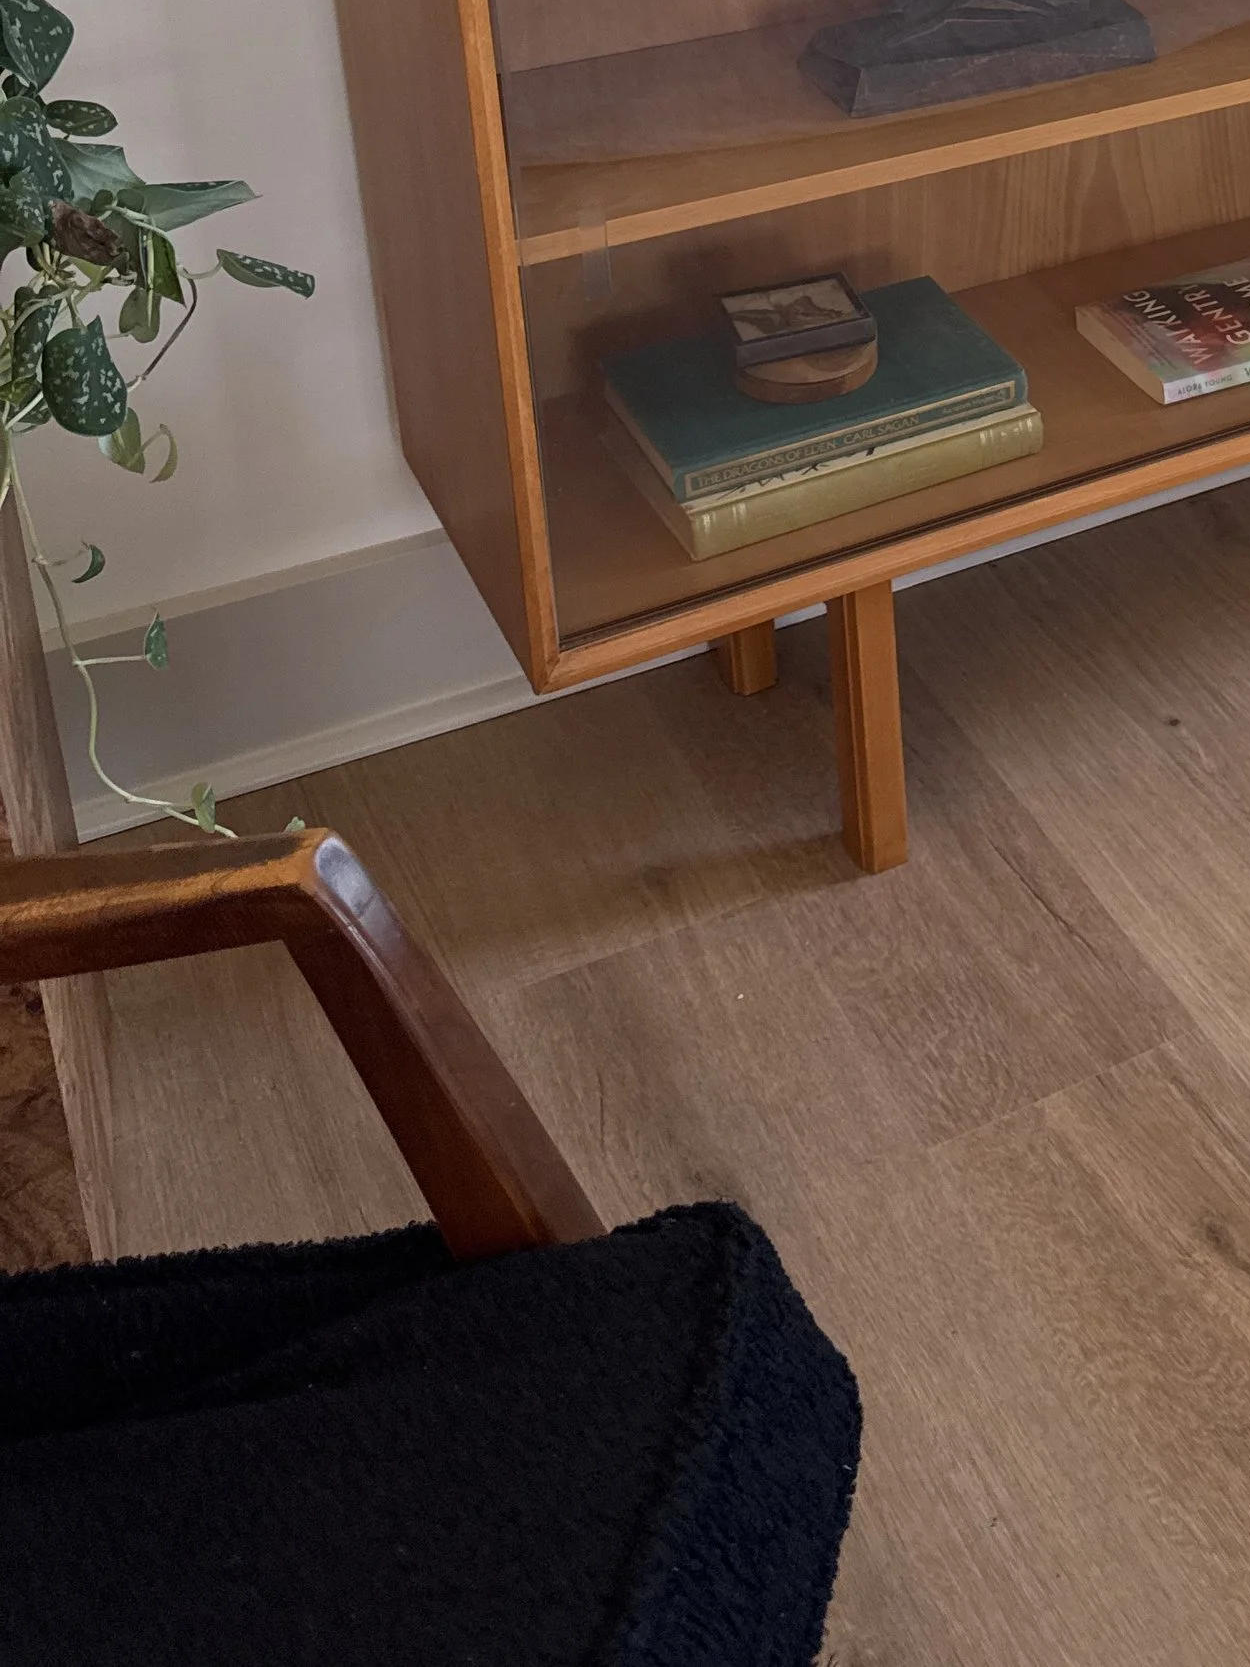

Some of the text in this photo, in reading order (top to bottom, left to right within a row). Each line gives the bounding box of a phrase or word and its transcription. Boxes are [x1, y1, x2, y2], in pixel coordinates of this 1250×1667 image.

[1122, 290, 1215, 367] WALKING
[722, 452, 785, 481] DRAGONS
[843, 428, 877, 446] CARL
[877, 414, 921, 436] SAGAN
